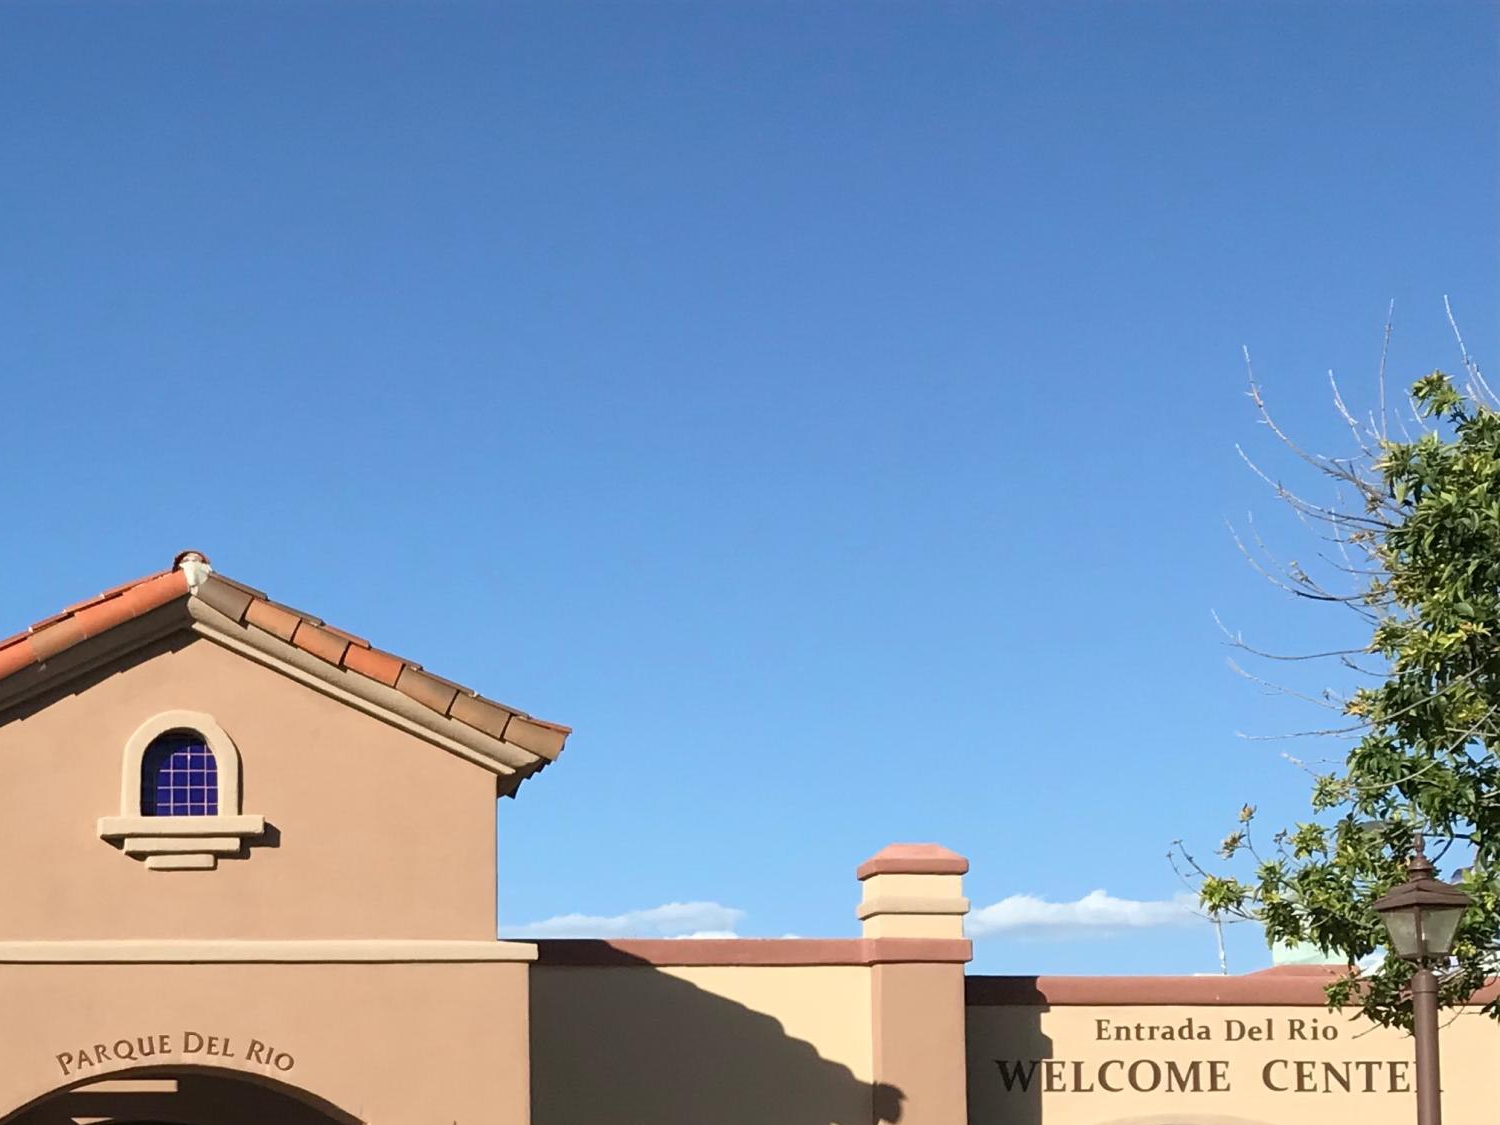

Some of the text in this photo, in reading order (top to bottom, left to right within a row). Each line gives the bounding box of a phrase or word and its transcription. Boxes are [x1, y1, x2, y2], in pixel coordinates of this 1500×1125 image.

[1095, 1018, 1339, 1042] Entrada Del Rio
[55, 1034, 172, 1076] PARQUE
[245, 1038, 295, 1072] RIO
[994, 1058, 1444, 1094] WELCOME CENTE
